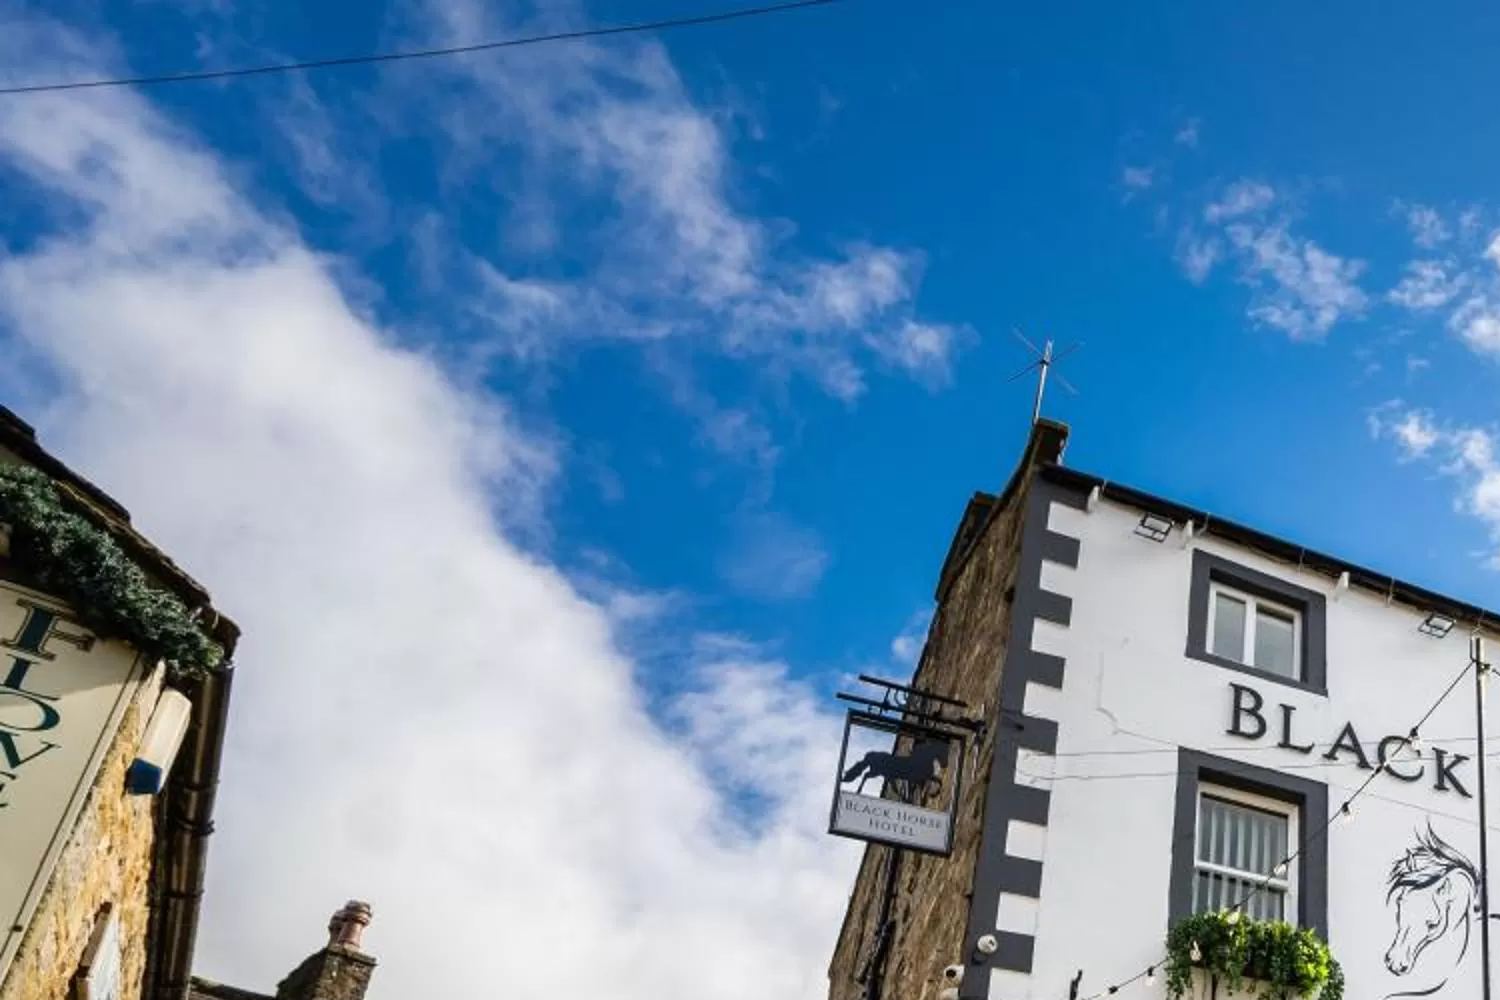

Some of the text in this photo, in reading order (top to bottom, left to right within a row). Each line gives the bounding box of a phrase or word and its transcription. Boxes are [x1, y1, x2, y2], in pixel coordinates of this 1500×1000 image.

[1226, 682, 1473, 799] BLACK
[845, 801, 942, 829] BLACK HORSE
[869, 819, 914, 836] HOTEL
